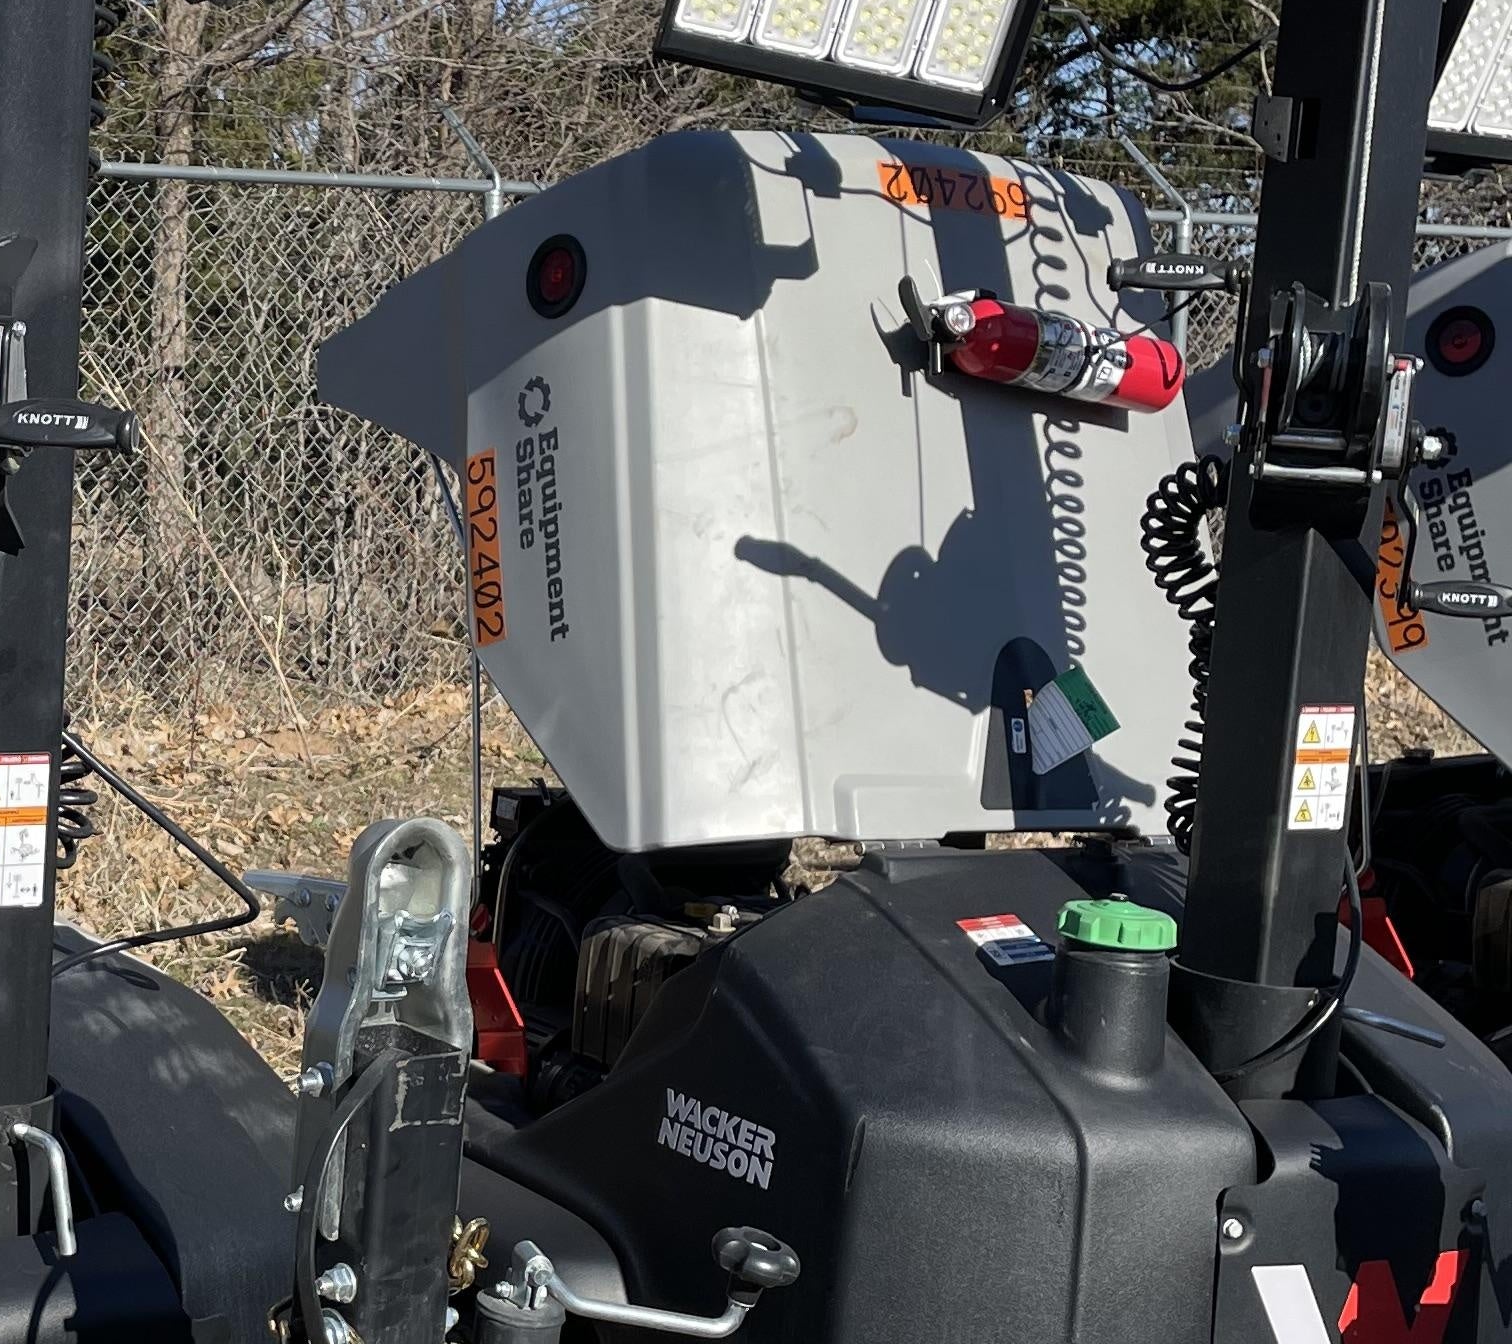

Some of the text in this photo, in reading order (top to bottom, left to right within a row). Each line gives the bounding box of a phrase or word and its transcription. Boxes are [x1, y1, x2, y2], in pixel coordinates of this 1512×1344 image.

[1157, 264, 1205, 275] KNOTT
[17, 413, 76, 427] KNOTT
[515, 436, 535, 551] Share
[1419, 476, 1456, 573] Share
[467, 456, 505, 644] 592402
[535, 426, 570, 643] Equipment
[1441, 592, 1487, 605] KNOTT
[657, 1116, 773, 1190] NEUSON
[666, 1087, 776, 1161] WACKER
